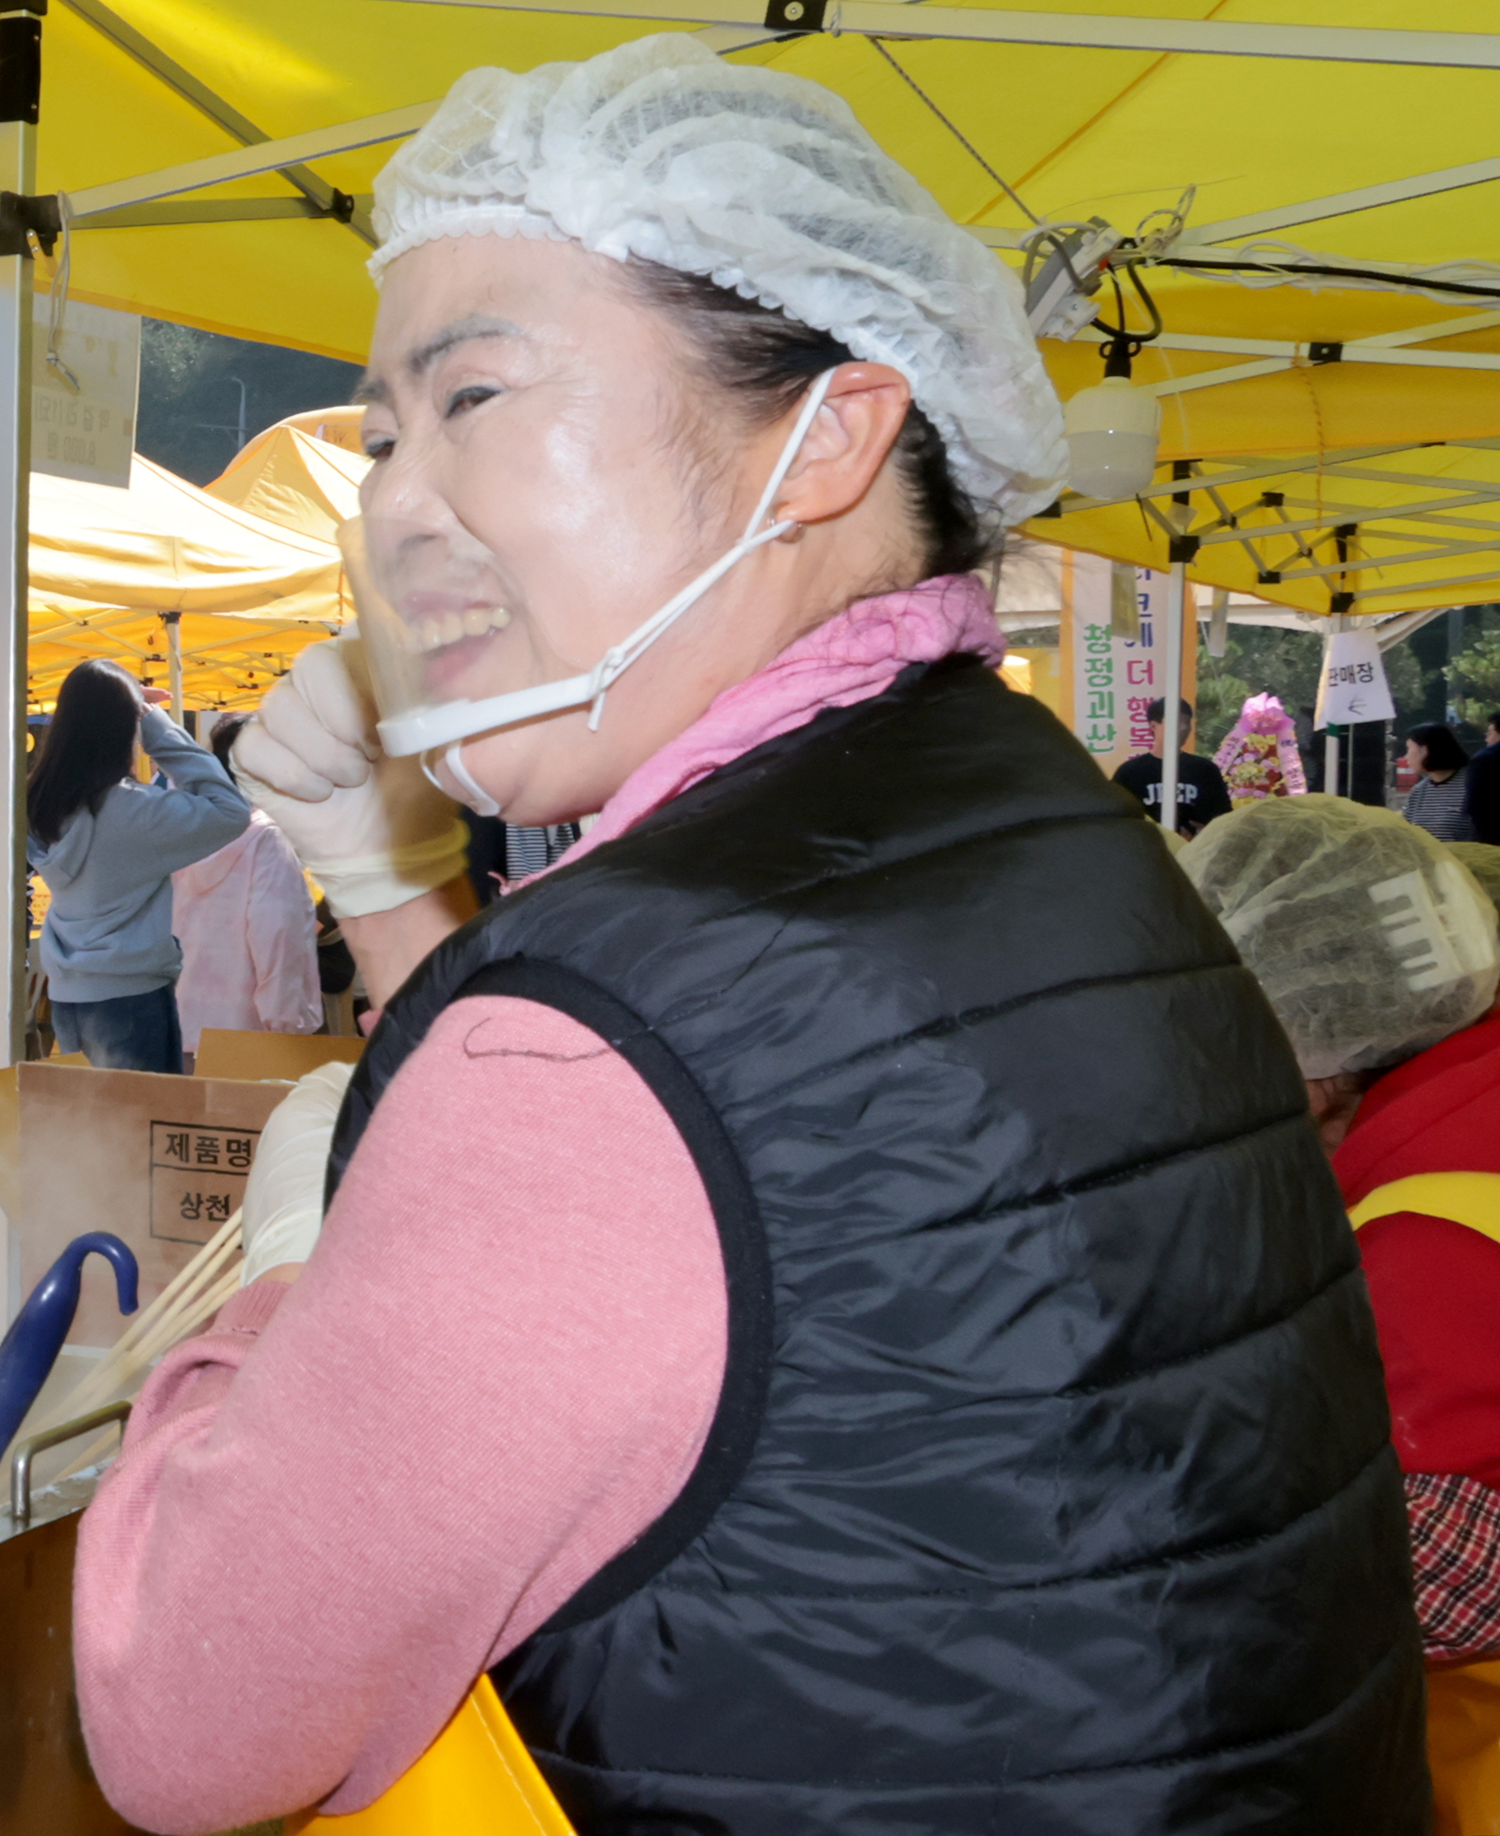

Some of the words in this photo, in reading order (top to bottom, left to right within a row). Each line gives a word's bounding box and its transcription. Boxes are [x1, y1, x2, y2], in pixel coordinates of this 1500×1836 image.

[1127, 659, 1154, 685] 더
[1328, 661, 1374, 687] 판매장
[1126, 696, 1156, 762] 행복
[164, 1132, 252, 1168] 제품명
